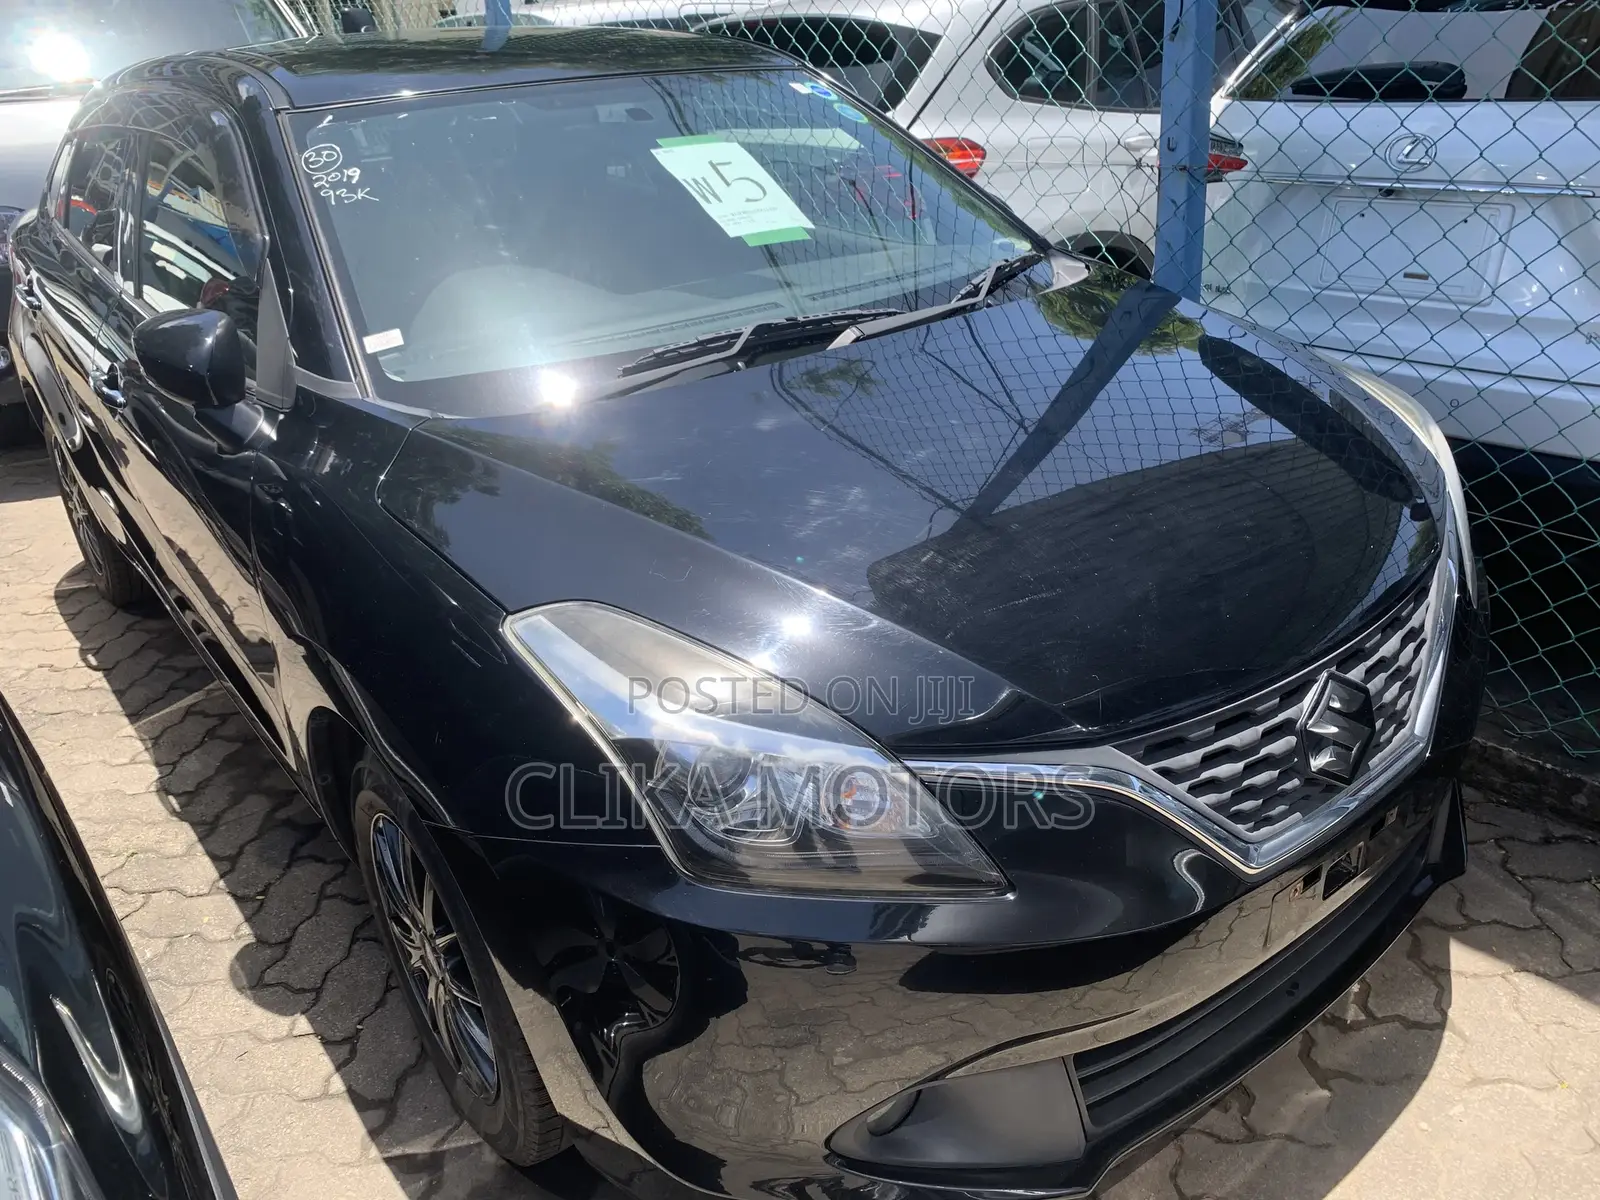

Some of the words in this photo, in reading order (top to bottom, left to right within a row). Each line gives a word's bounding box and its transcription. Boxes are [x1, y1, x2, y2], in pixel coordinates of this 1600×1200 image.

[305, 151, 338, 168] 30
[312, 167, 361, 188] 2019
[320, 187, 380, 205] 93K
